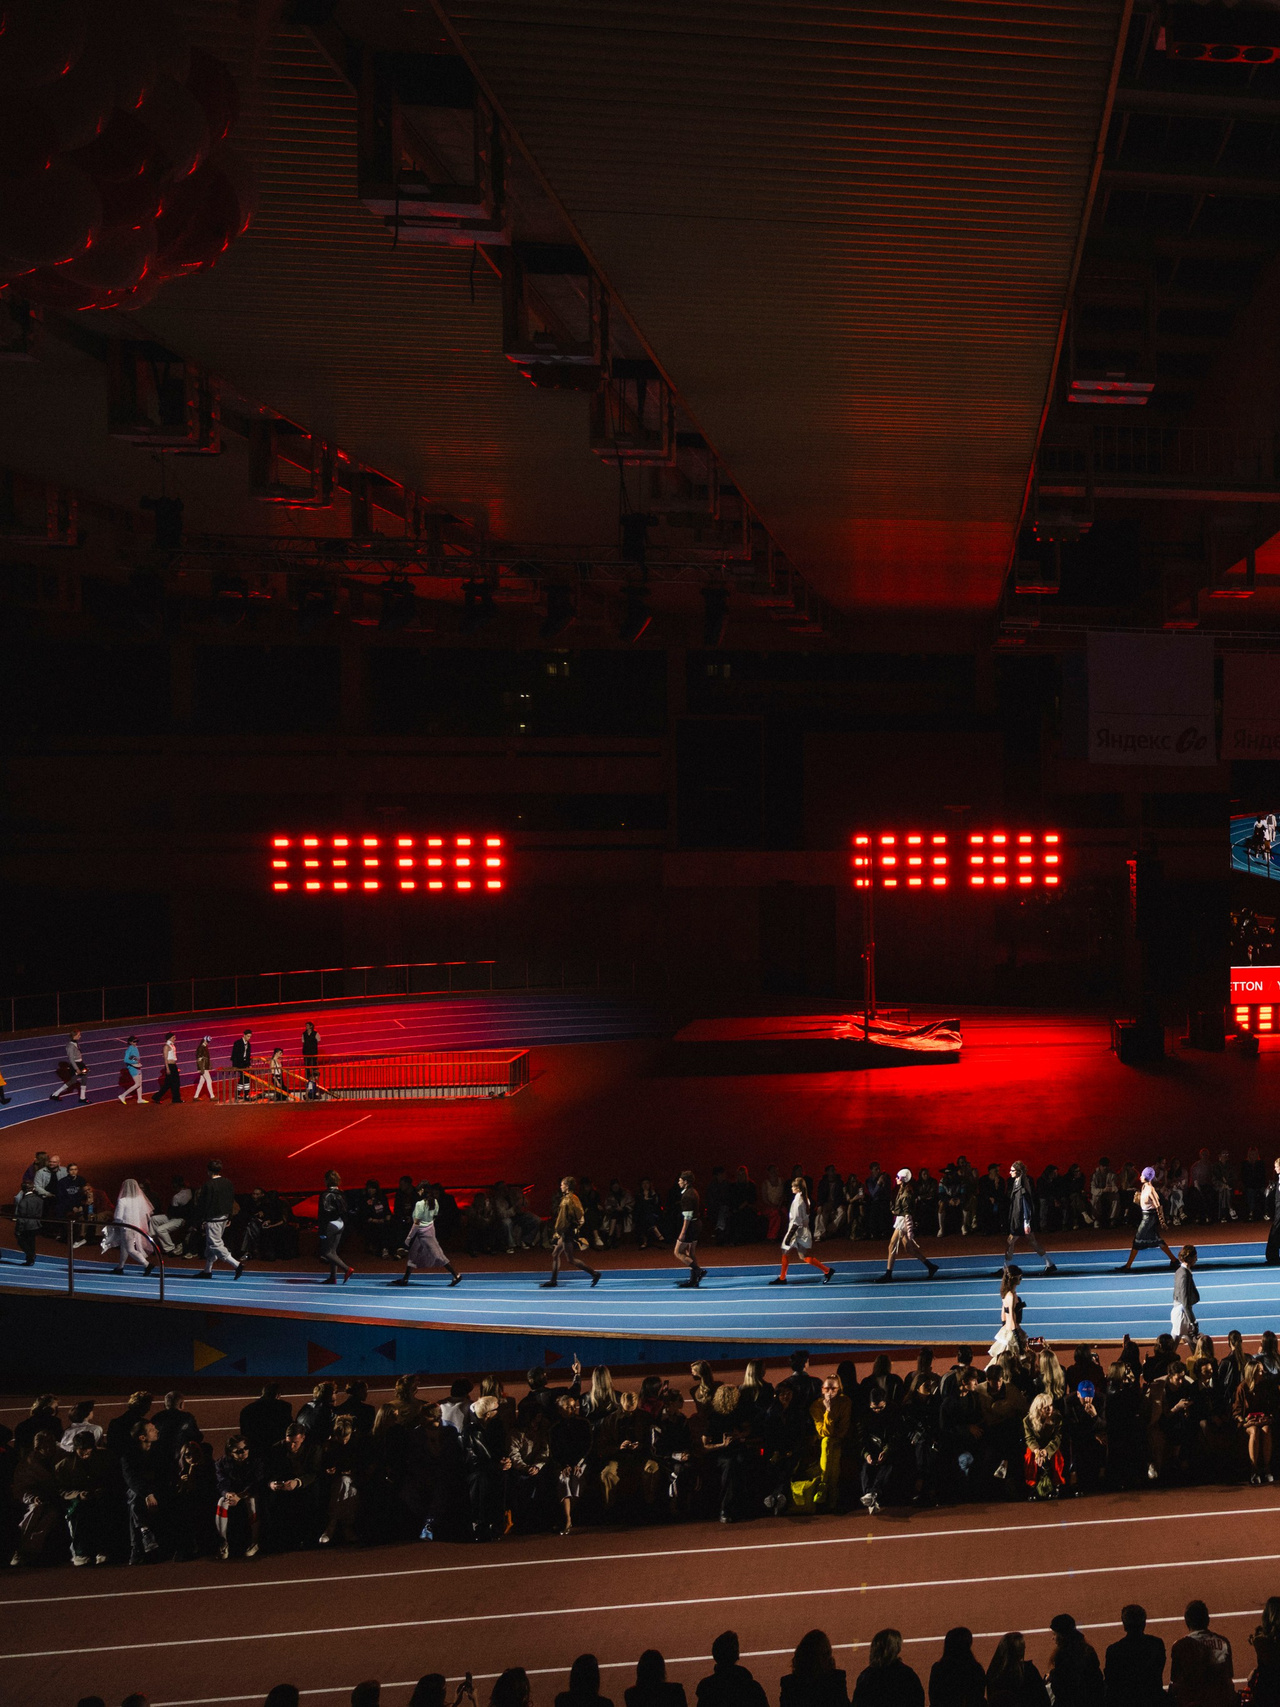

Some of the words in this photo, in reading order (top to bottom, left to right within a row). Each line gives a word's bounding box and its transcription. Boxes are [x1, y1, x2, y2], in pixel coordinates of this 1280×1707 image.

[1096, 728, 1171, 752] Яндекс
[1175, 727, 1208, 753] Go
[1230, 981, 1263, 991] TTON
